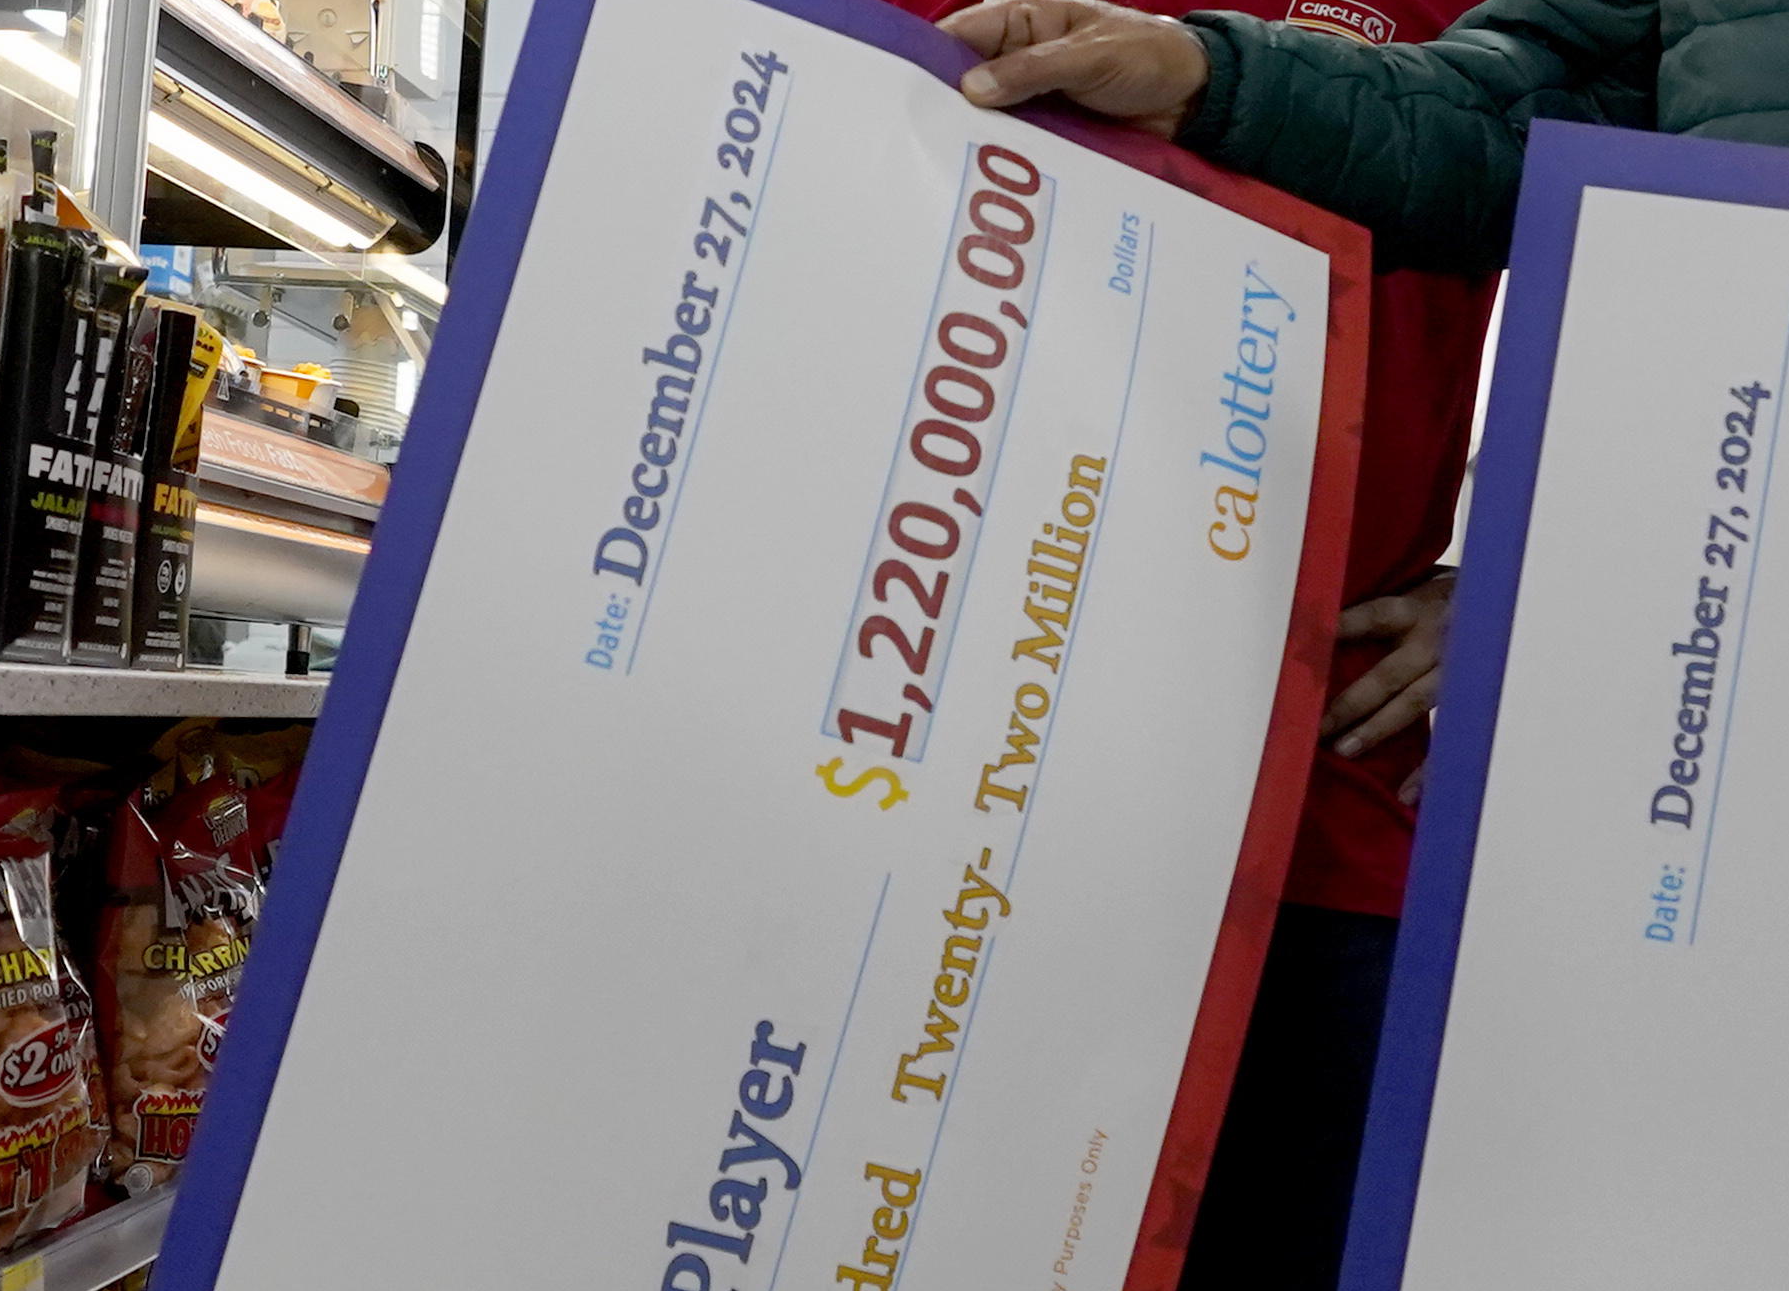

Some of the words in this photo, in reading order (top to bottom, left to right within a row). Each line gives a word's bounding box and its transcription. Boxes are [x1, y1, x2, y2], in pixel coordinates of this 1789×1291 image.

[1300, 1, 1362, 26] CIRCLE
[1364, 17, 1384, 40] K
[717, 50, 790, 177] 2024
[693, 187, 751, 270] 27,
[1106, 212, 1140, 297] Dollars
[592, 273, 719, 589] December
[837, 143, 1043, 758] 1,220,000,000
[1201, 264, 1298, 564] calottery
[1716, 381, 1772, 494] 2024
[1011, 451, 1106, 675] Million
[1705, 505, 1751, 569] 27,
[584, 592, 633, 672] Date:
[973, 682, 1052, 814] Two
[1649, 575, 1730, 831] December
[814, 757, 910, 811] $
[1644, 864, 1687, 944] Date:
[891, 848, 1013, 1103] Twenty-
[1054, 1184, 1092, 1276] Purposes
[1081, 1127, 1108, 1175] Only
